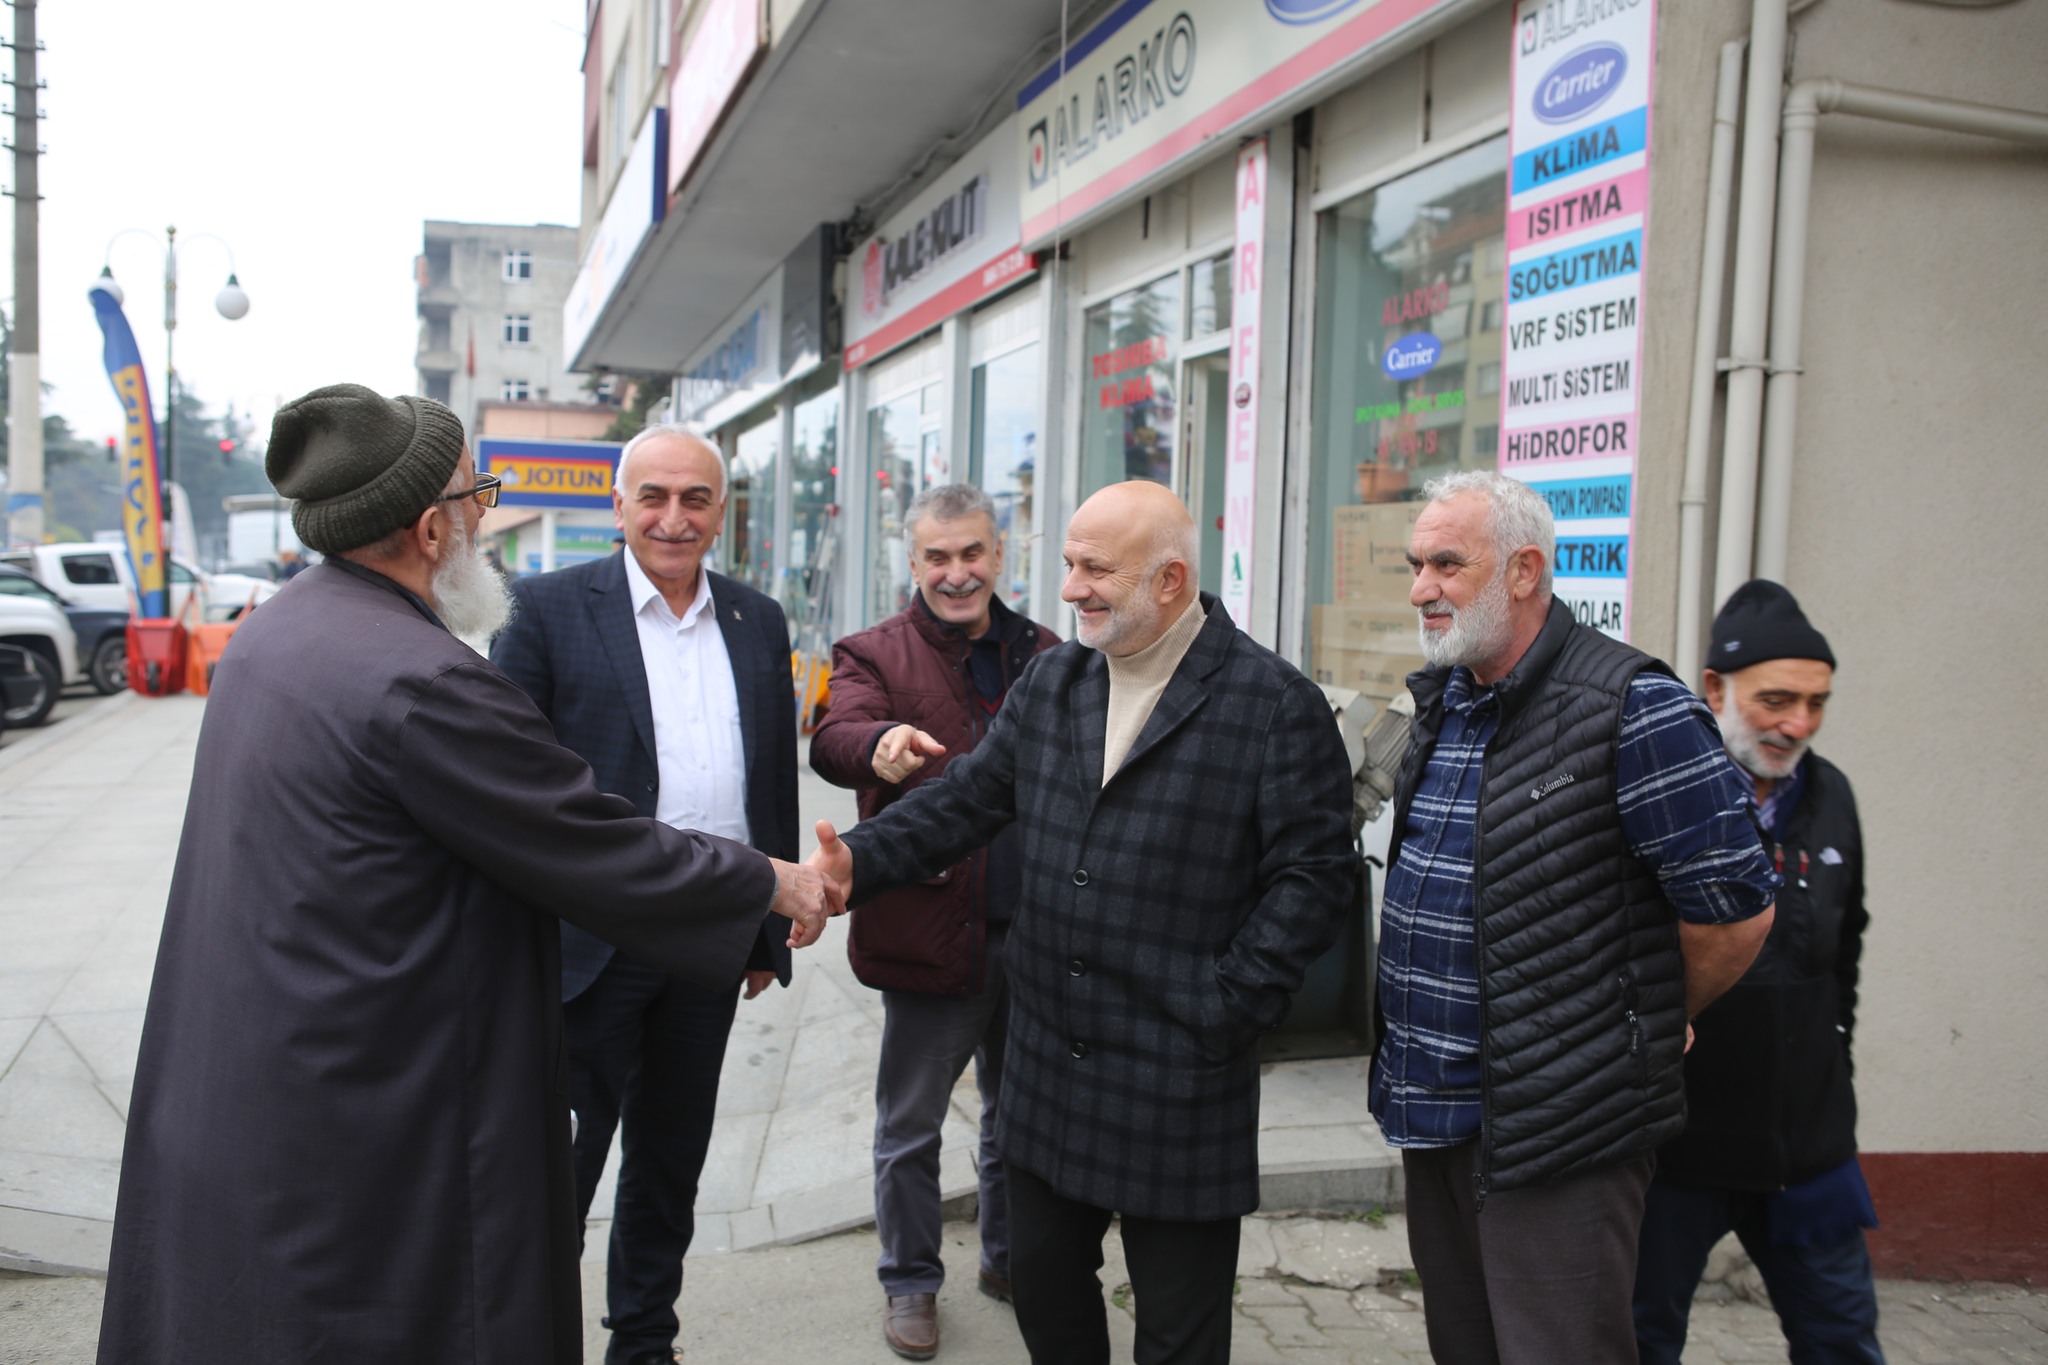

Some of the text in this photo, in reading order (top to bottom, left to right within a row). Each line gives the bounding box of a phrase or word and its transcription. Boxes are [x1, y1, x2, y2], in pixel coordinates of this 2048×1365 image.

[1052, 10, 1197, 175] ALARKO
[1542, 58, 1616, 109] Carrier
[1527, 184, 1623, 239] ISITMA
[1511, 240, 1637, 300] SOĞUTMA
[1381, 281, 1449, 327] ALARKO
[1386, 342, 1436, 371] Carrier
[1509, 317, 1548, 351] VRF
[1091, 335, 1167, 380] TOSHIBA
[524, 467, 605, 488] JOTUN
[1578, 485, 1628, 516] POMPASI
[1539, 773, 1575, 796] Columbia
